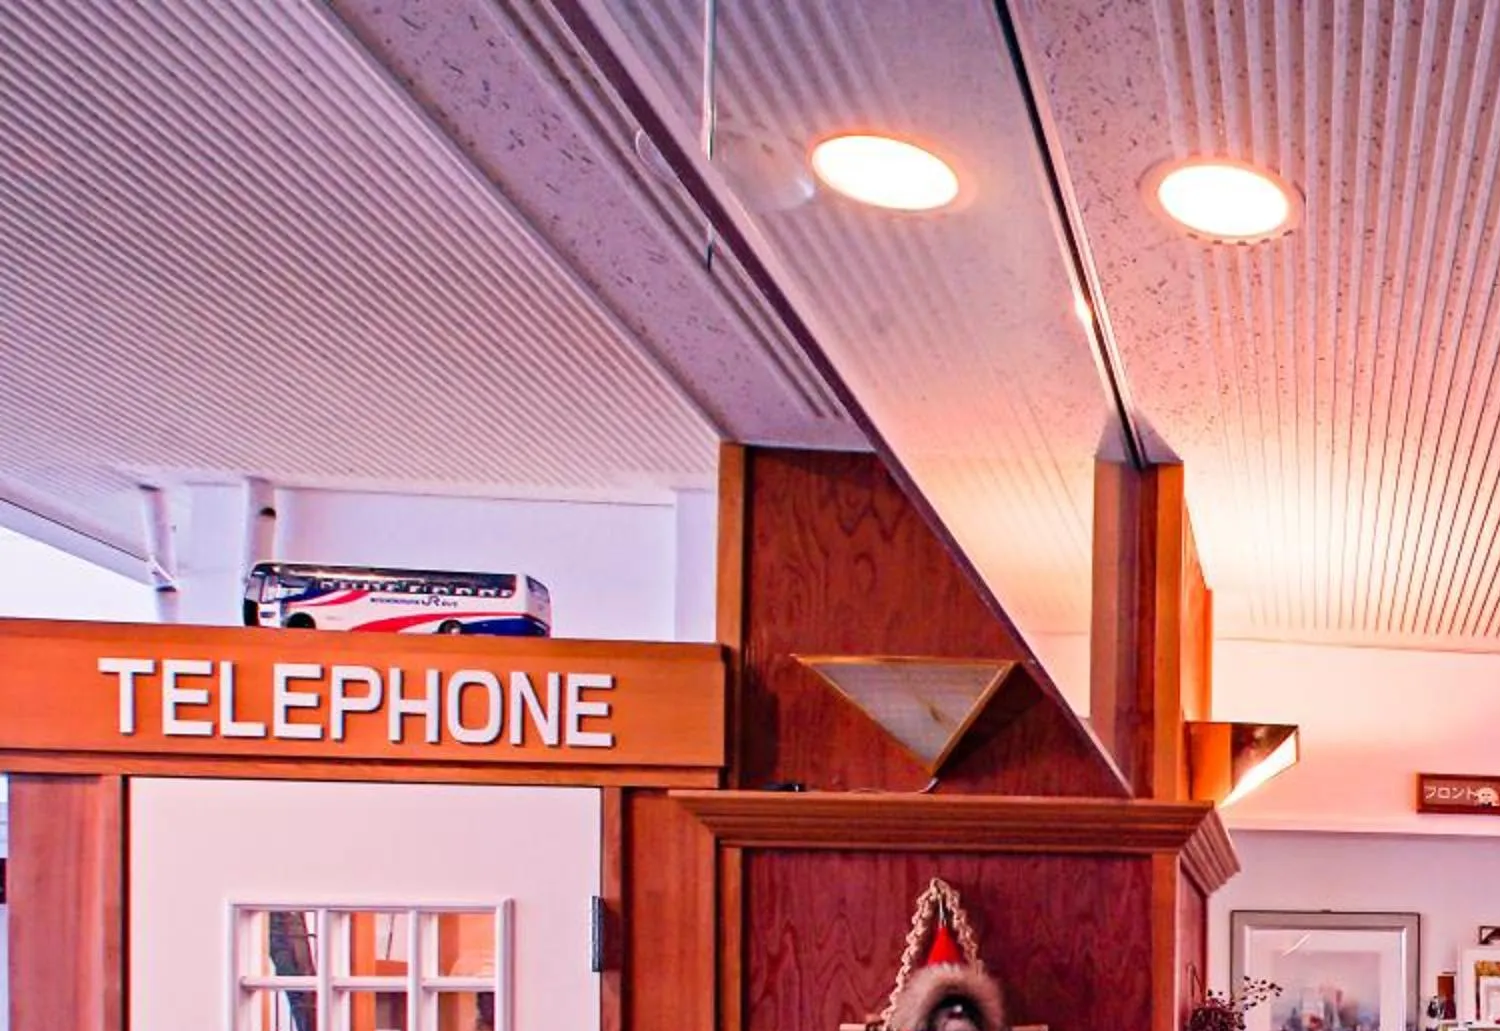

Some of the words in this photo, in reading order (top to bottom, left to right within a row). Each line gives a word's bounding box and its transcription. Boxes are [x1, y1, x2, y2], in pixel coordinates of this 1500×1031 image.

[97, 656, 616, 749] TELEPHONE
[1423, 785, 1478, 801] フロント
